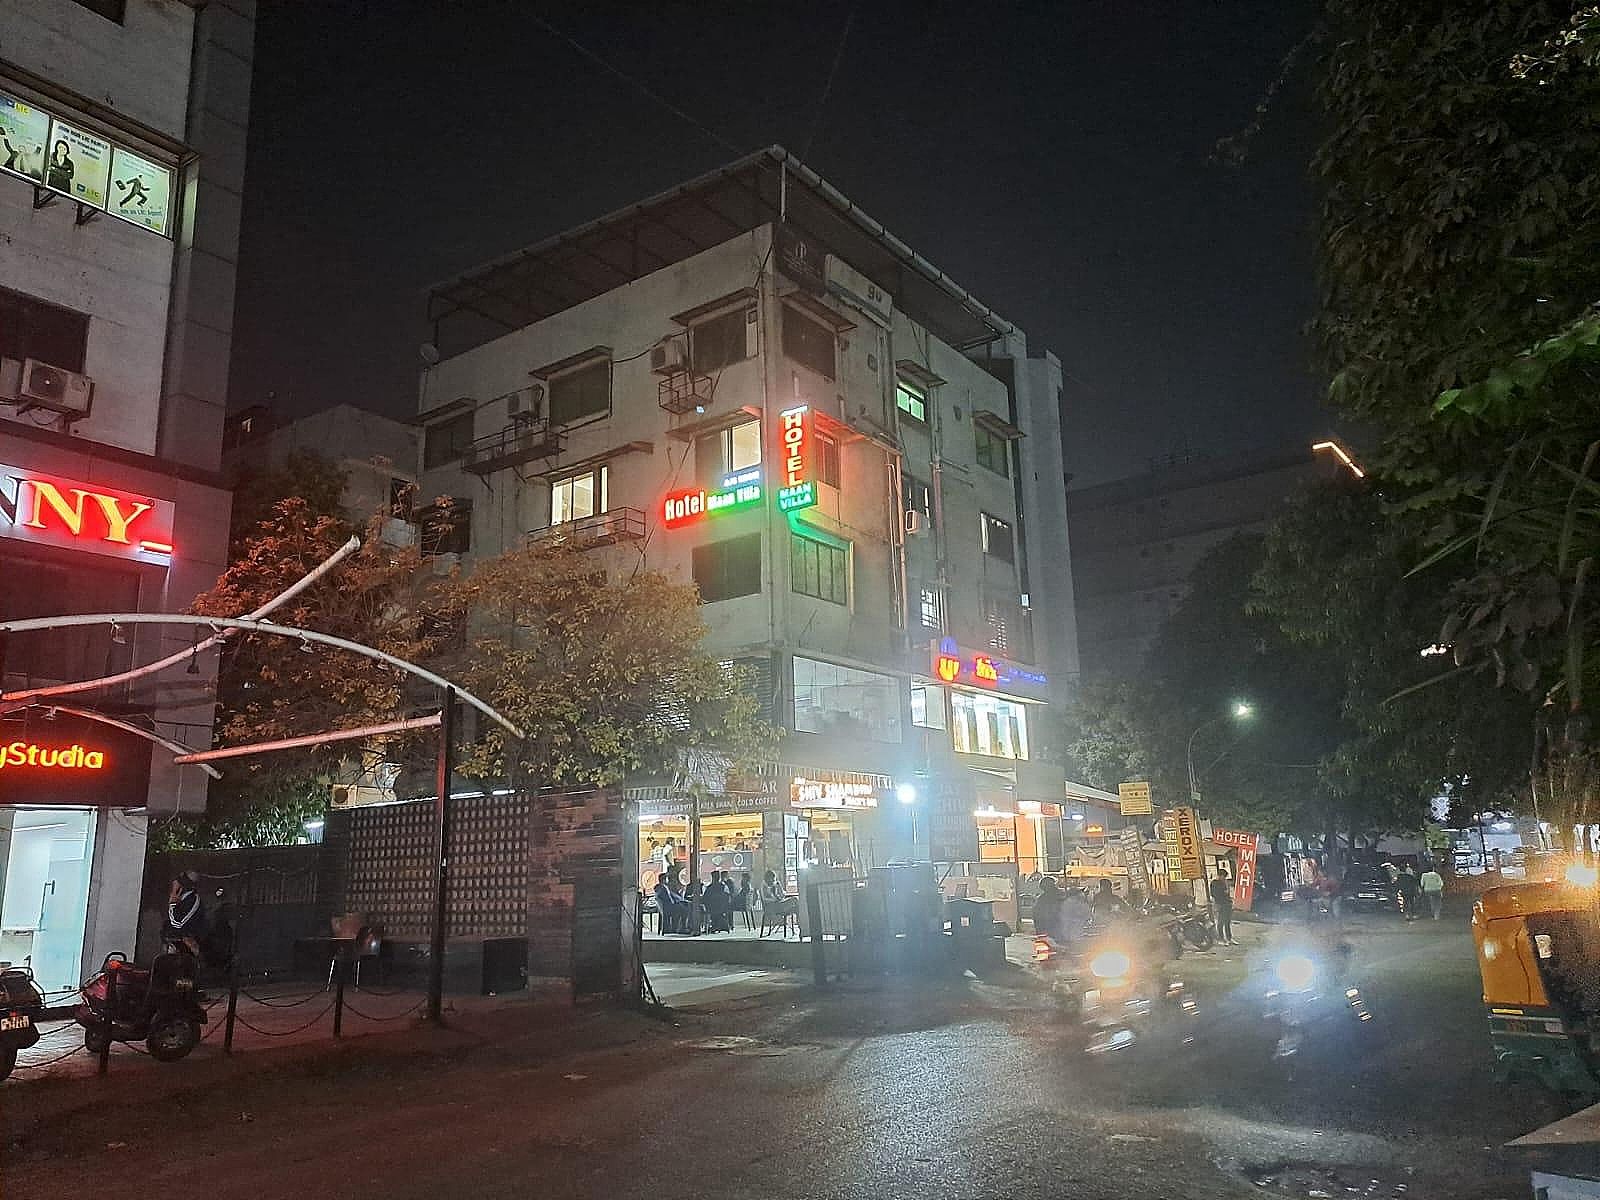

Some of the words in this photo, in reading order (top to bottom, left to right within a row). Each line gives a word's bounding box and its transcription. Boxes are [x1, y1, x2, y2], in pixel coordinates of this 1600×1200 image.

[784, 412, 803, 487] HOTEL
[665, 490, 705, 521] Hotel
[781, 494, 812, 511] VILLA
[1178, 808, 1193, 855] XEROX
[1216, 831, 1253, 846] HOTEL
[1239, 849, 1254, 899] MAHI
